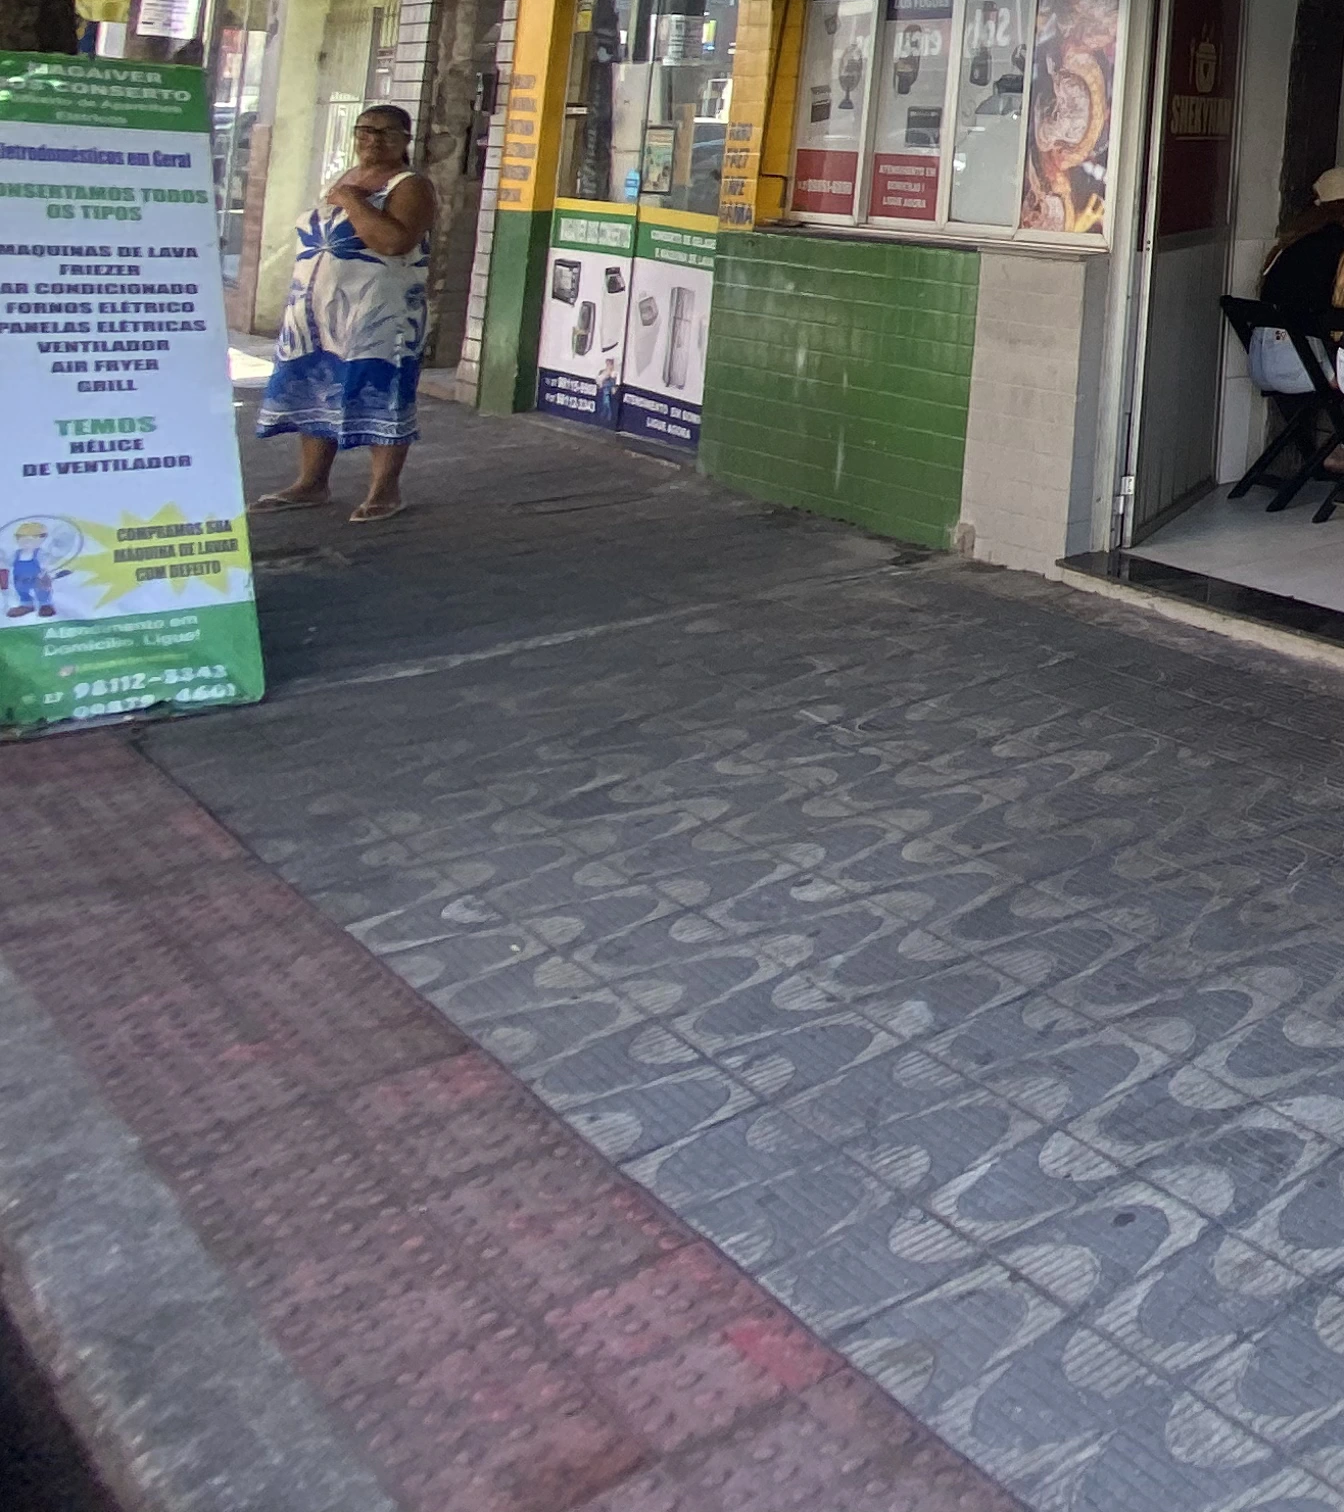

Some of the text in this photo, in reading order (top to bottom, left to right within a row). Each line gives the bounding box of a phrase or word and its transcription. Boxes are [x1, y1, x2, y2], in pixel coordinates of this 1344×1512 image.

[1170, 94, 1232, 135] SHEKYNAH
[140, 188, 208, 204] TODOS
[47, 203, 142, 221] OS TIPOS
[0, 243, 199, 258] MAQUINAS DE LAVA
[0, 283, 199, 295] AR CONDICIONADO
[6, 299, 195, 314] FORNOS ELÉTRICO
[0, 319, 207, 334] PANELAS ELÉTRICAS
[37, 339, 170, 354] VENTILADOR
[51, 358, 160, 374] AIR FRYER
[77, 379, 139, 393] GRILL
[54, 416, 158, 436] TEMOS
[69, 438, 145, 454] HÉLICE
[22, 454, 193, 477] DE VENTILADOR
[116, 519, 233, 543] COMPRAMOS SUA
[178, 542, 195, 558] DE
[135, 560, 222, 582] COM DEFEITO
[44, 614, 199, 640] Atendimento em
